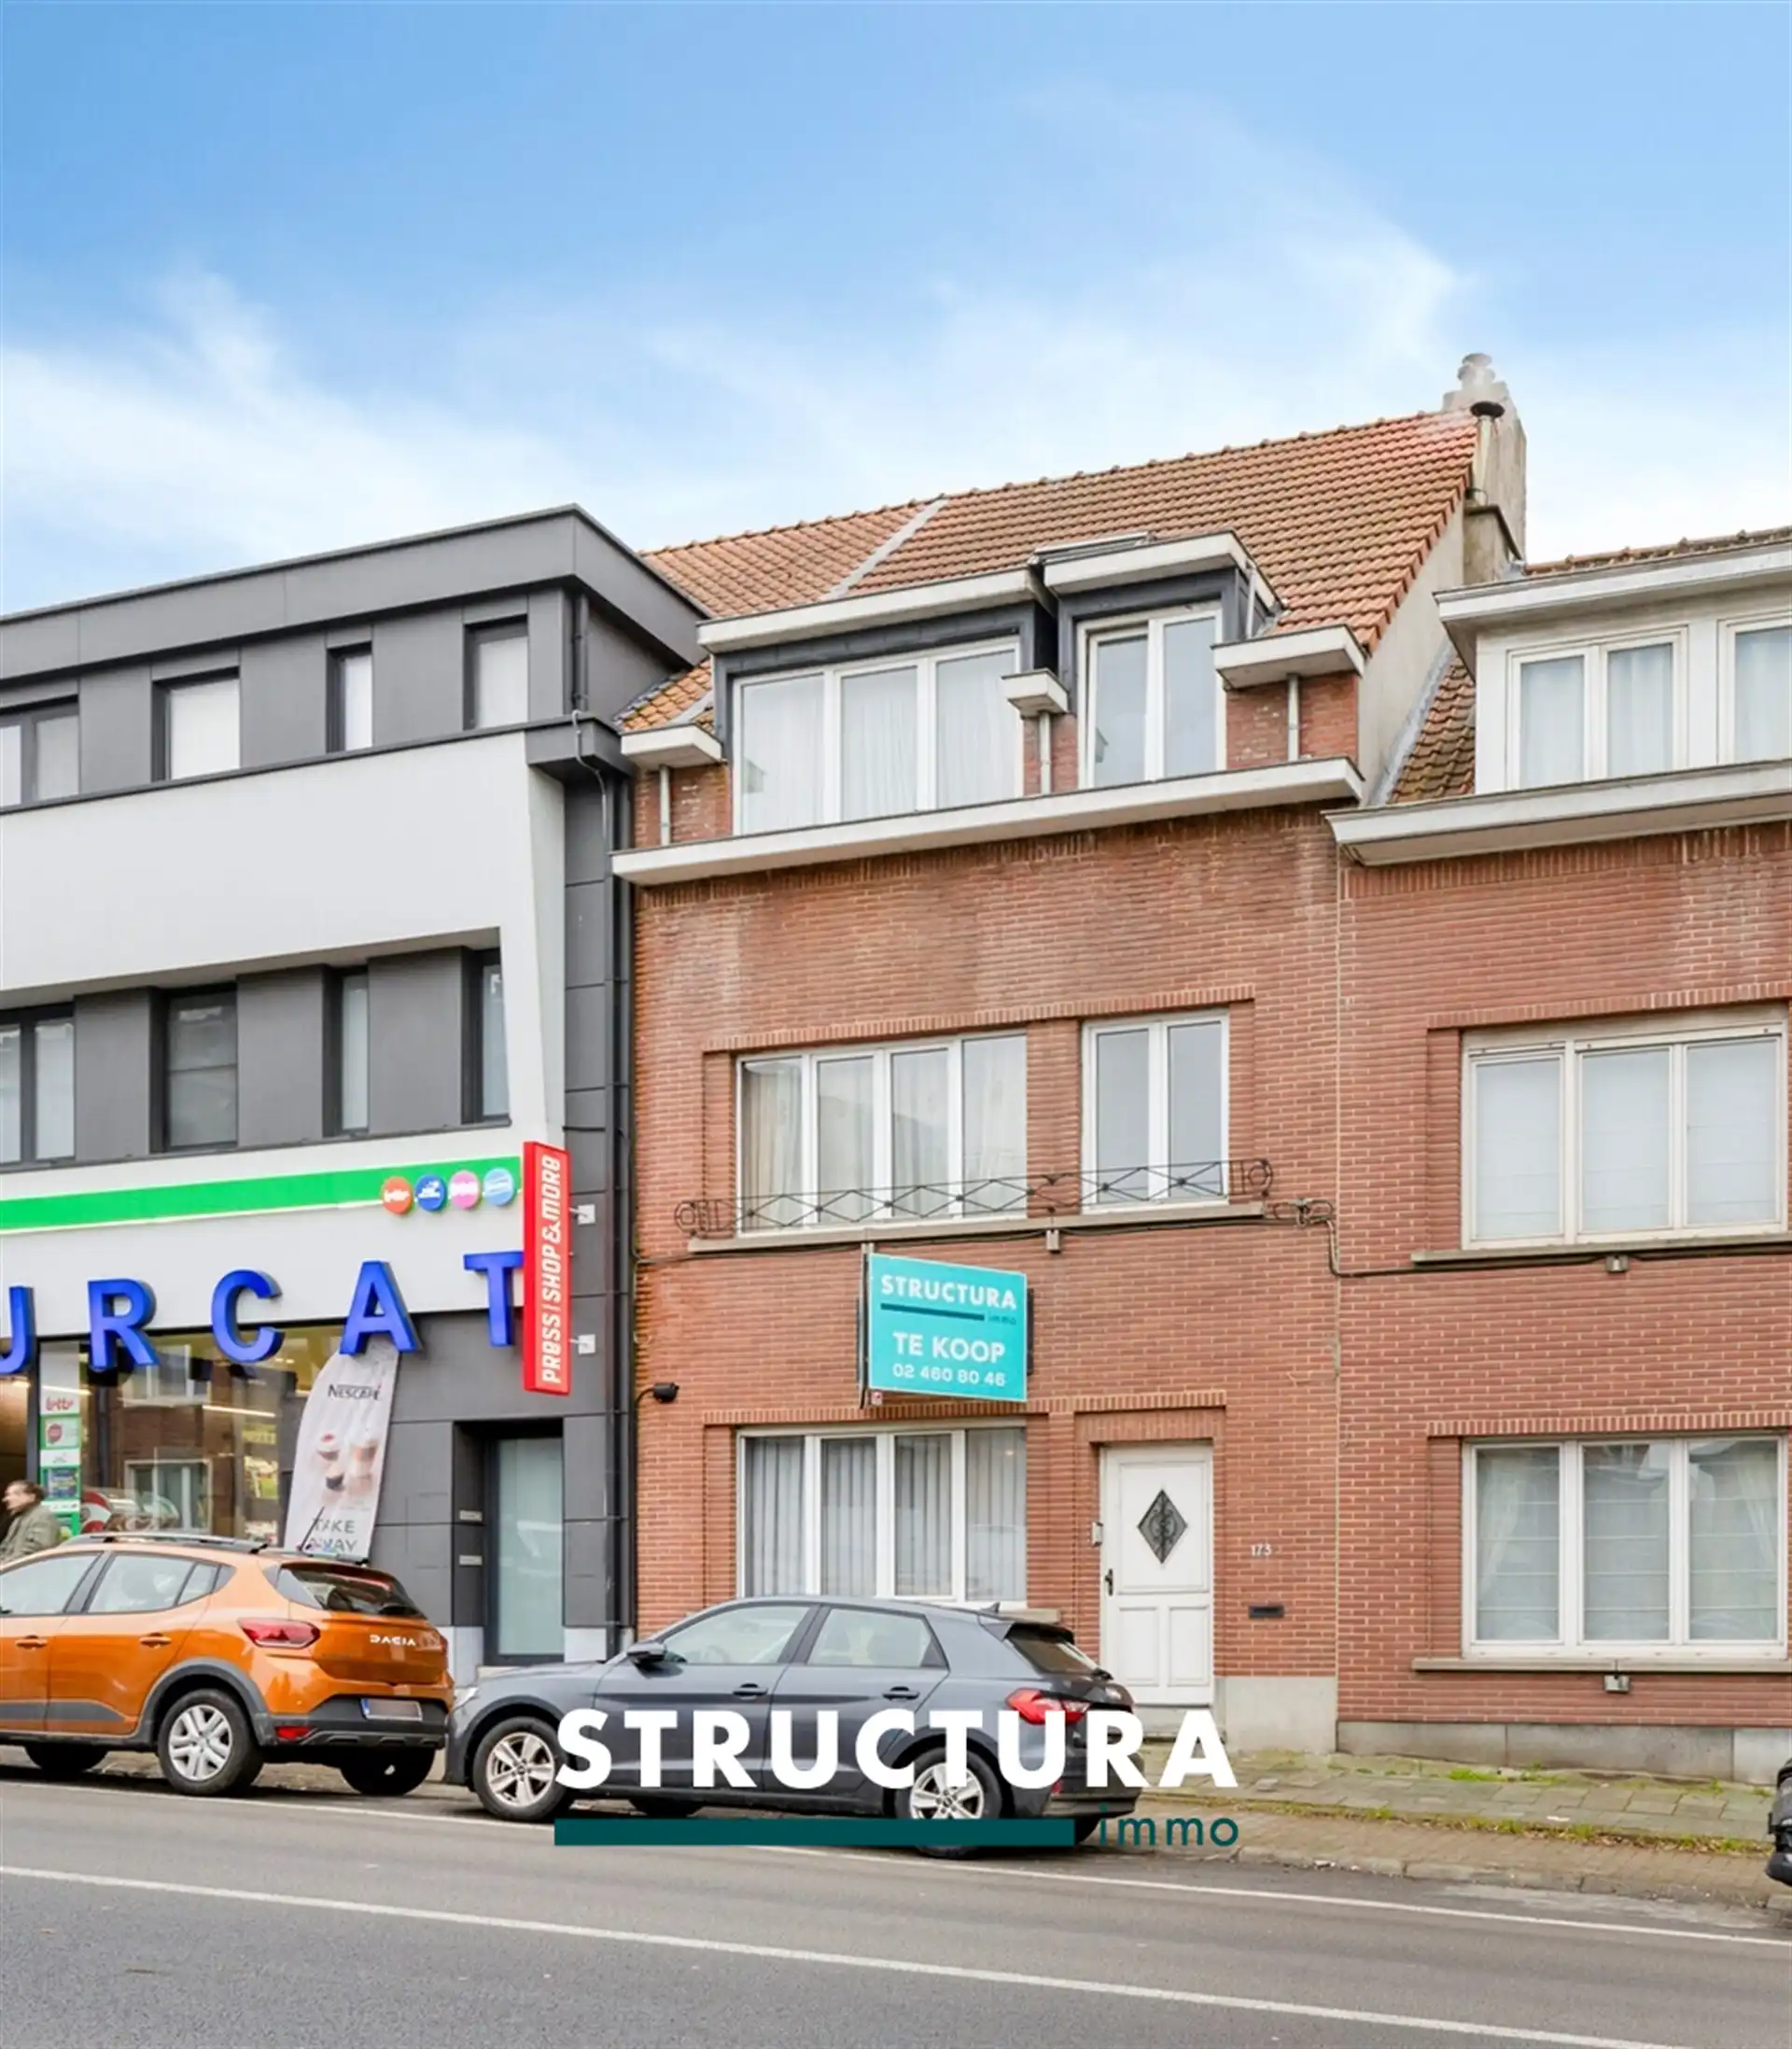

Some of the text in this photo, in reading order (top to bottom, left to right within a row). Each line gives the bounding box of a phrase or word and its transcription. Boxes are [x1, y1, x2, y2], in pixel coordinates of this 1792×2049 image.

[541, 1243, 562, 1303] SHOP
[880, 1274, 1017, 1310] STRUCTURA
[892, 1332, 1006, 1364] TE KOOP
[892, 1363, 915, 1379] 02
[370, 1634, 416, 1647] DACIA
